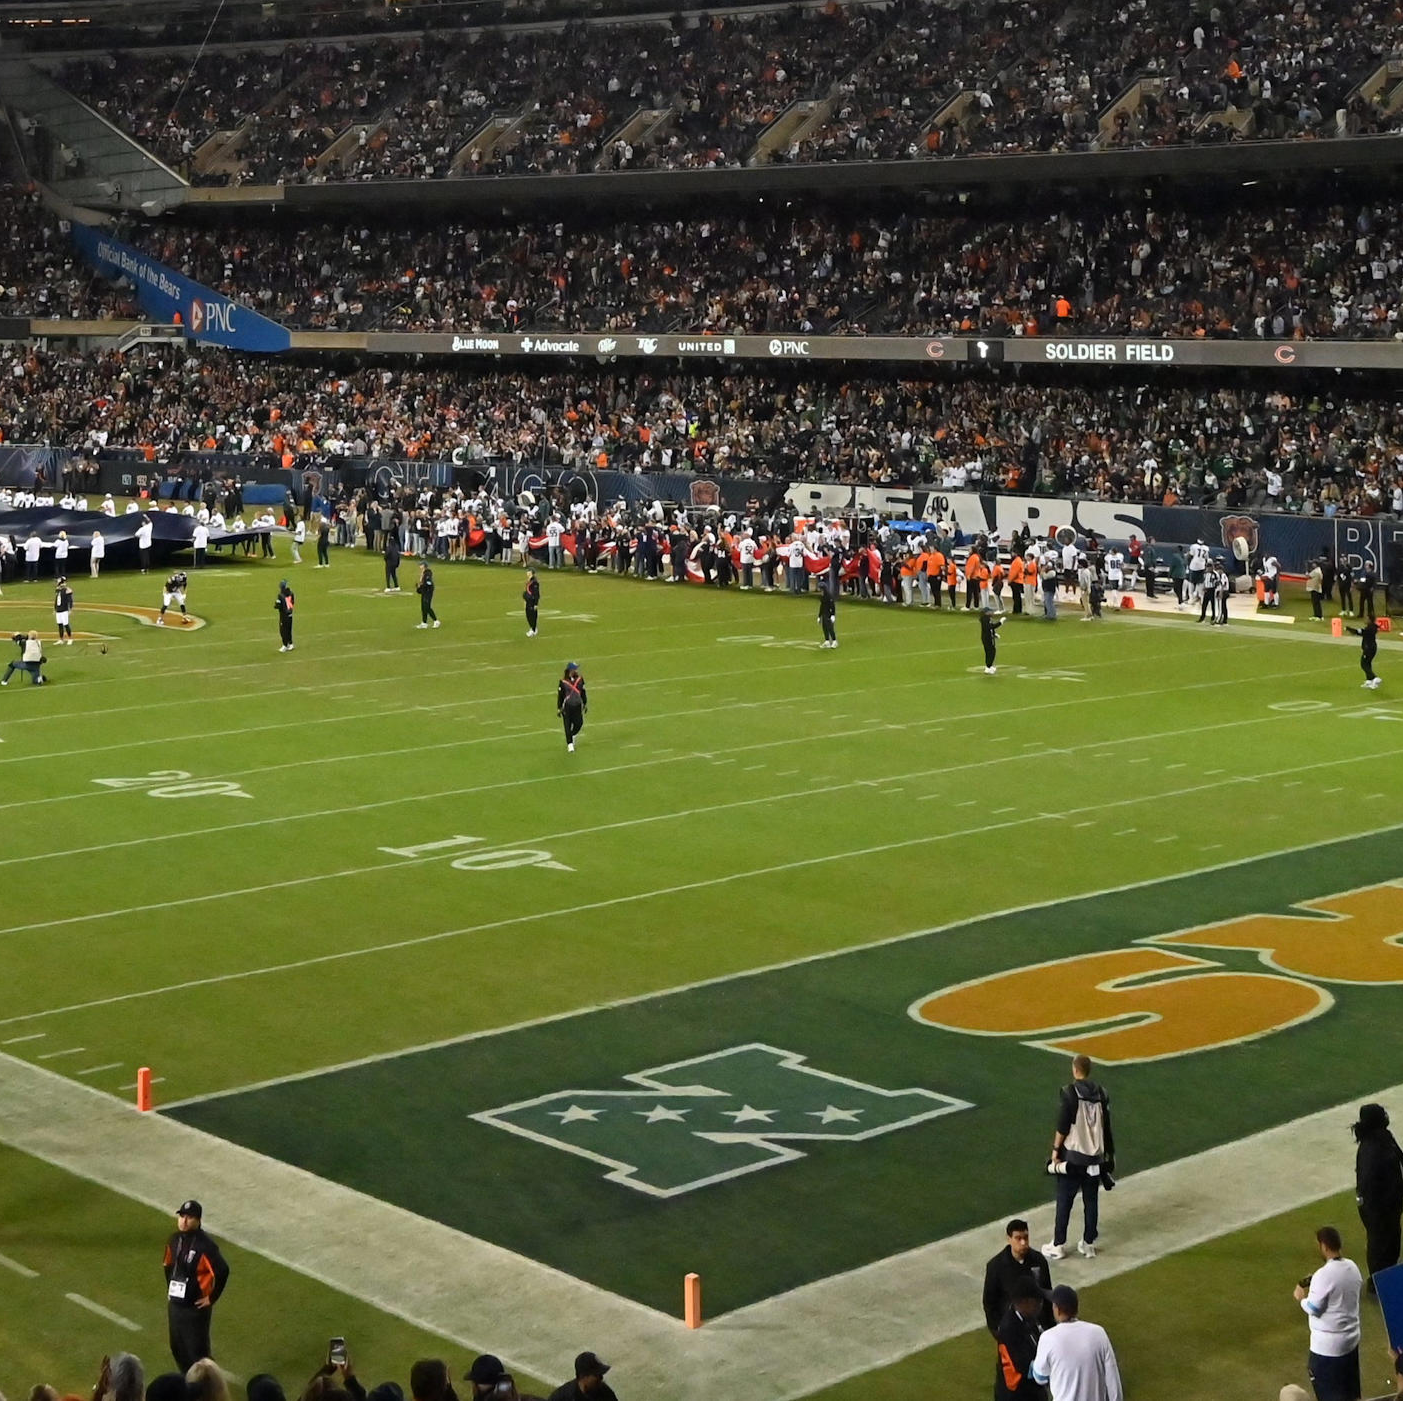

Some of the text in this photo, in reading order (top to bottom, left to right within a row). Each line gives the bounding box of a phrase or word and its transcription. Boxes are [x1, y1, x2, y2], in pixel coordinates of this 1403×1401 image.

[121, 252, 138, 276] Bank
[139, 262, 147, 278] of
[146, 266, 159, 286] the
[159, 273, 181, 299] Bears
[206, 303, 236, 332] PNC
[534, 339, 579, 351] Advocate
[678, 342, 722, 352] UNITED
[783, 341, 809, 354] PNC
[1046, 343, 1174, 361] SOLDIER FIELD
[90, 770, 243, 799] 20
[378, 834, 554, 871] 10
